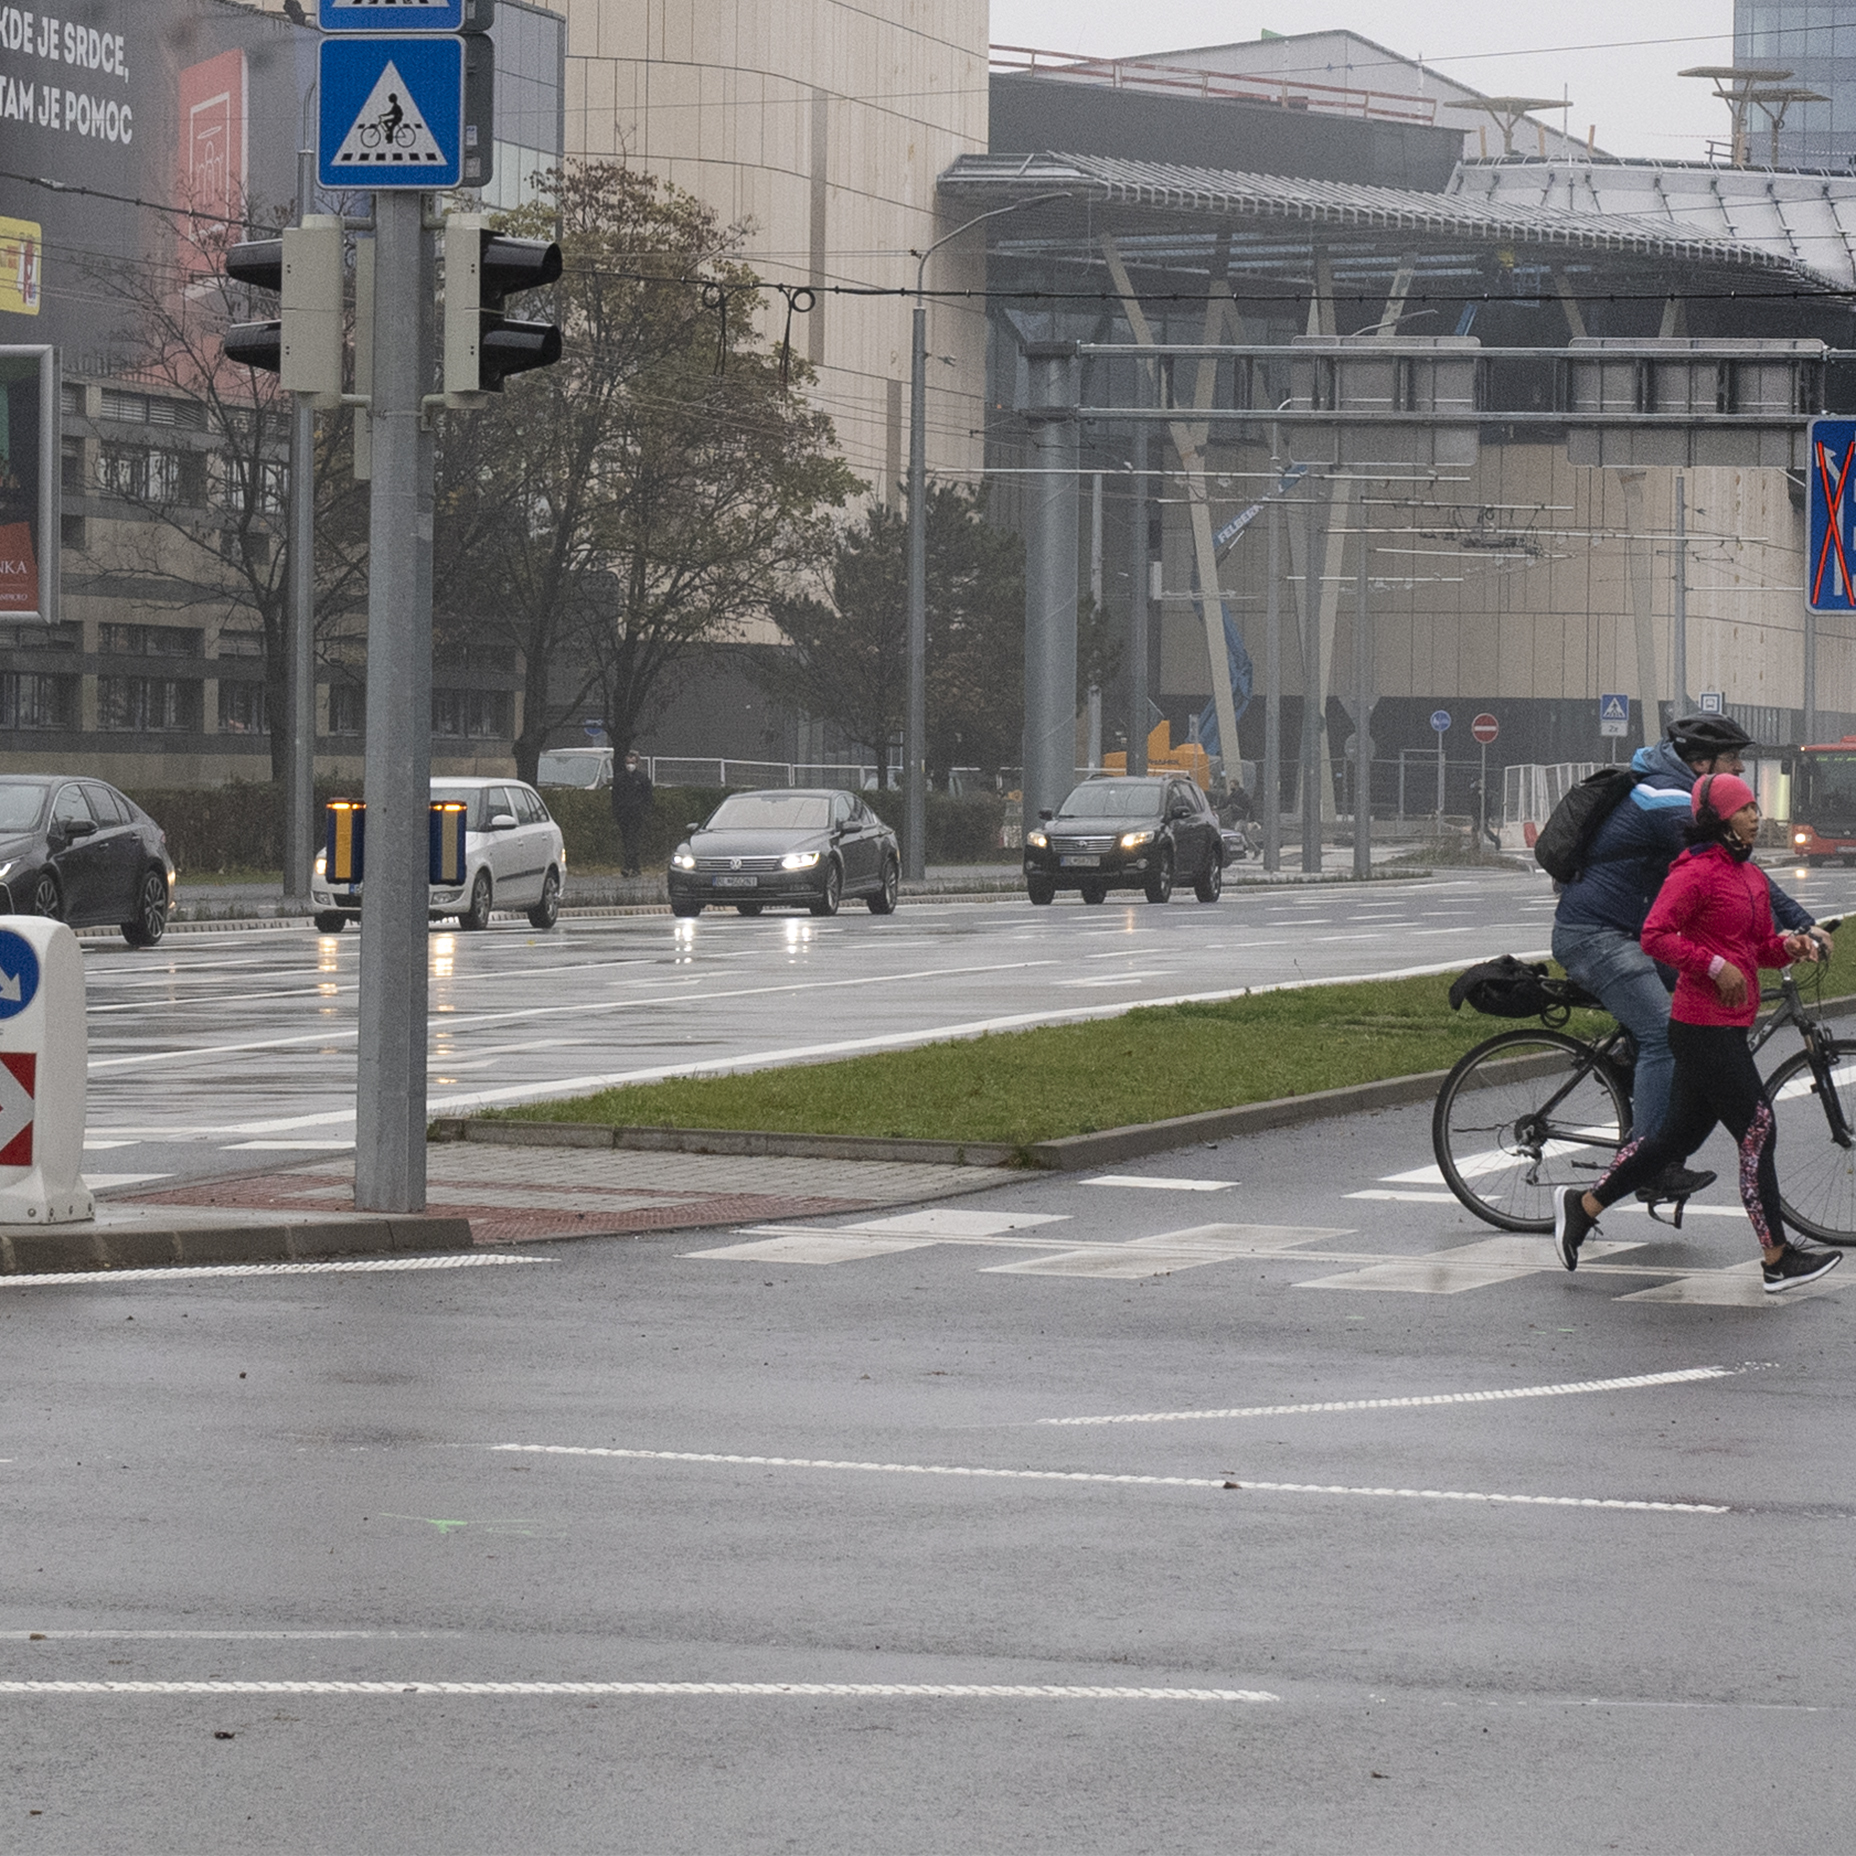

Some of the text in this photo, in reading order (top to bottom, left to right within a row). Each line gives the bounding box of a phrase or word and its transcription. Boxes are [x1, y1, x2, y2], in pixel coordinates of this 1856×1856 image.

[36, 15, 59, 61] JE
[62, 22, 130, 84] SRDCE,
[36, 84, 61, 129] JE
[64, 90, 134, 146] POMOC
